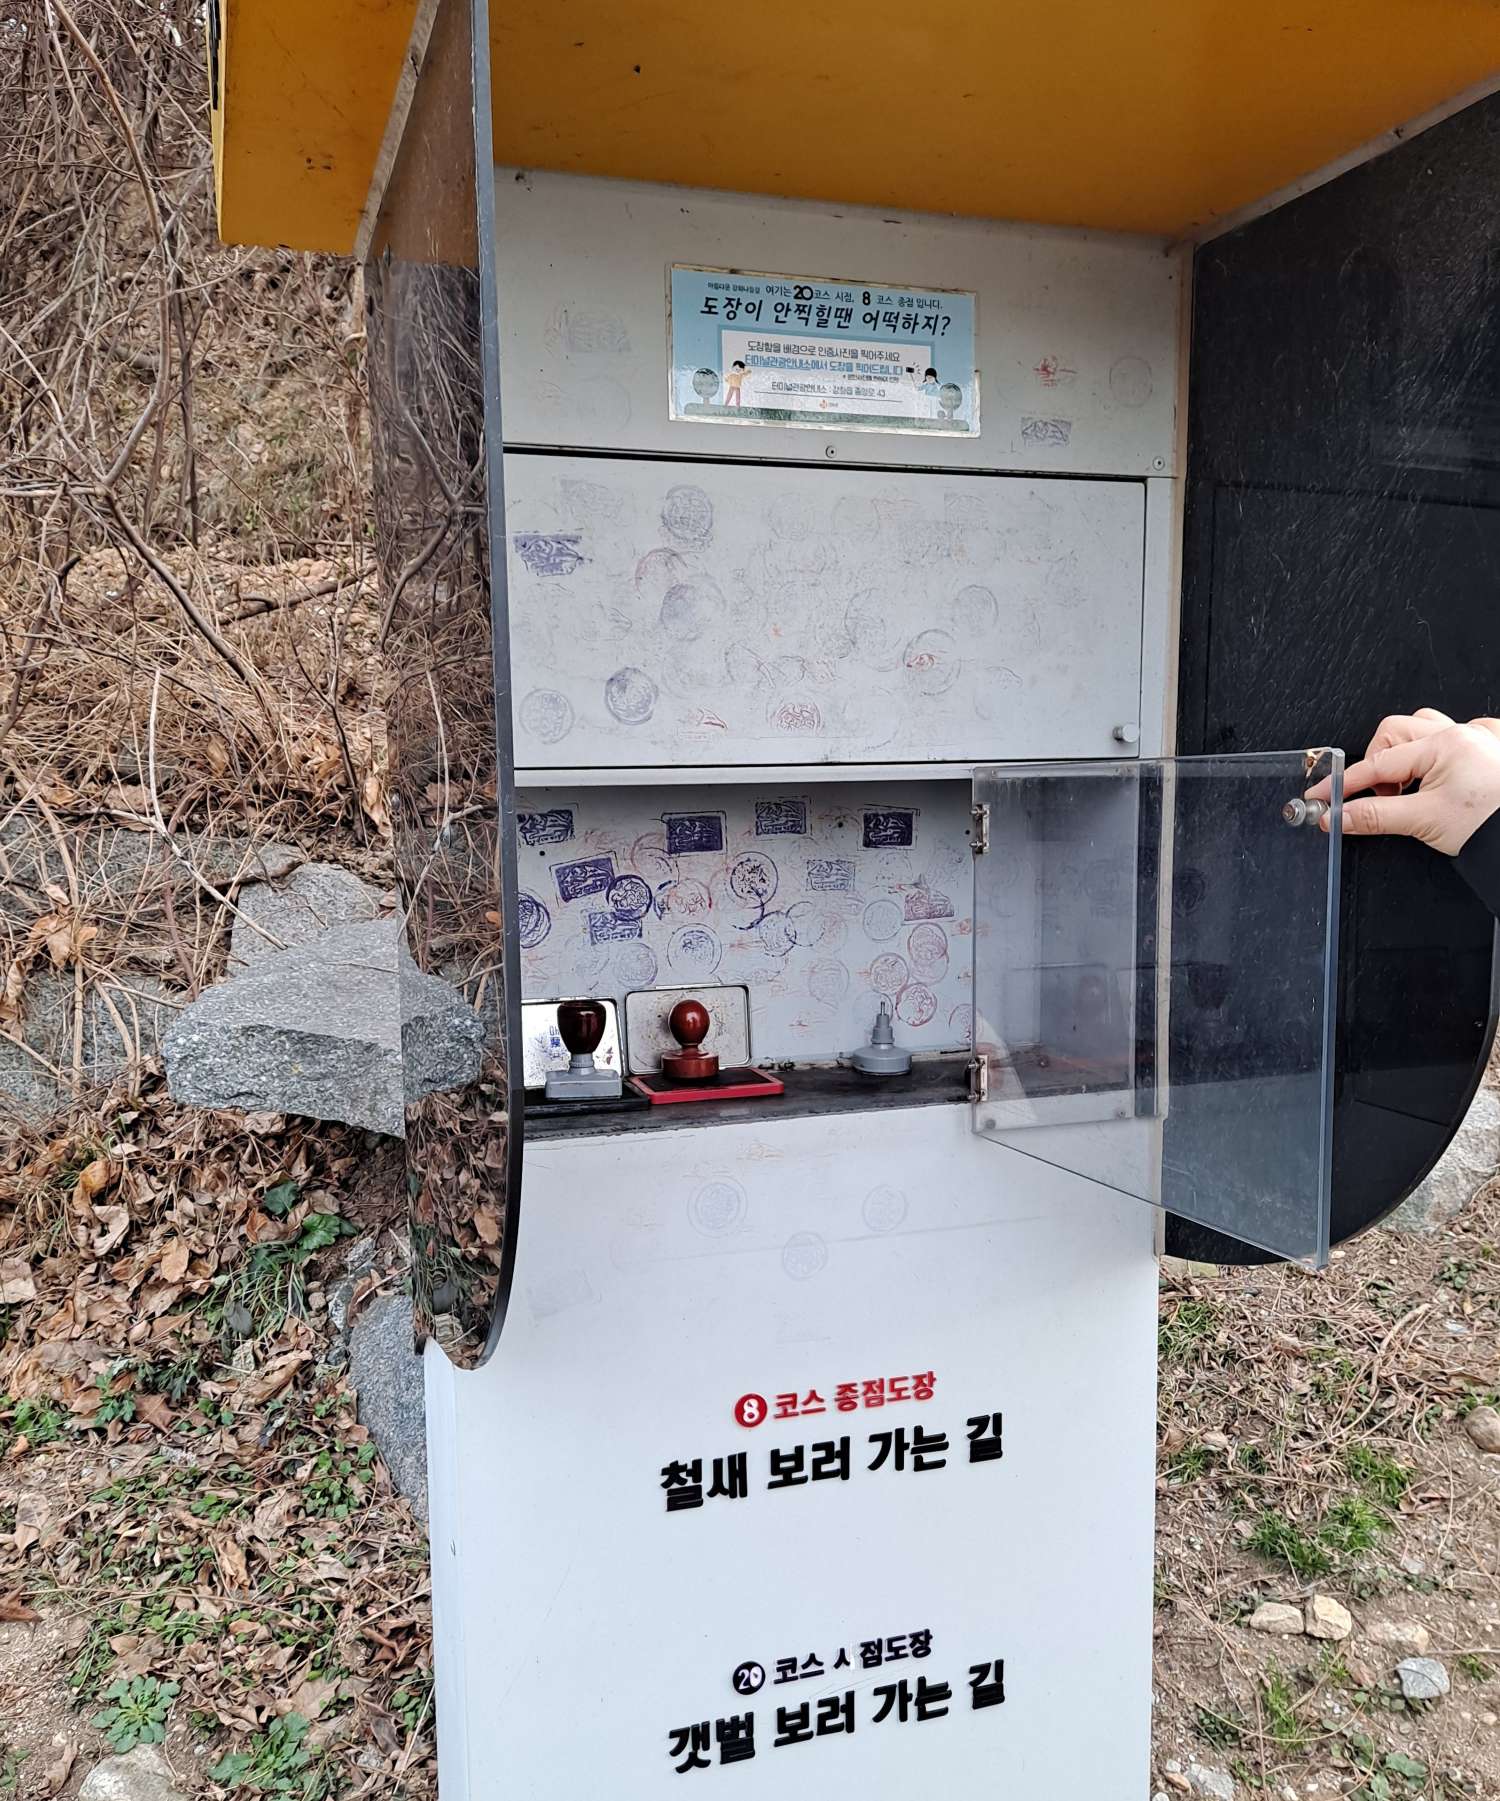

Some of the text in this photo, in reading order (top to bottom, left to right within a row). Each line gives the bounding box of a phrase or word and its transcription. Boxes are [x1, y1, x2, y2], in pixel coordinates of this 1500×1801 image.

[700, 296, 951, 336] 도장이 안찍힐땐 어떡하지?
[765, 285, 793, 297] 여기는
[862, 291, 871, 306] 8
[876, 295, 893, 305] 코스
[898, 296, 914, 308] 종점
[745, 354, 903, 376] 터미널관광안내소에서 도장을 찍어드립니다
[747, 340, 900, 362] 도장함을 배경으로 인증사진을 찍어주세요
[771, 381, 827, 394] 터미널관광안내소
[772, 1390, 826, 1420] 코스
[834, 1371, 937, 1412] 종점도장
[660, 1412, 1004, 1513] 철새 보러 가는 길
[736, 1663, 764, 1692] 20
[773, 1652, 825, 1685] 코스
[669, 1658, 1006, 1775] 갯벌 보러 가는 길
